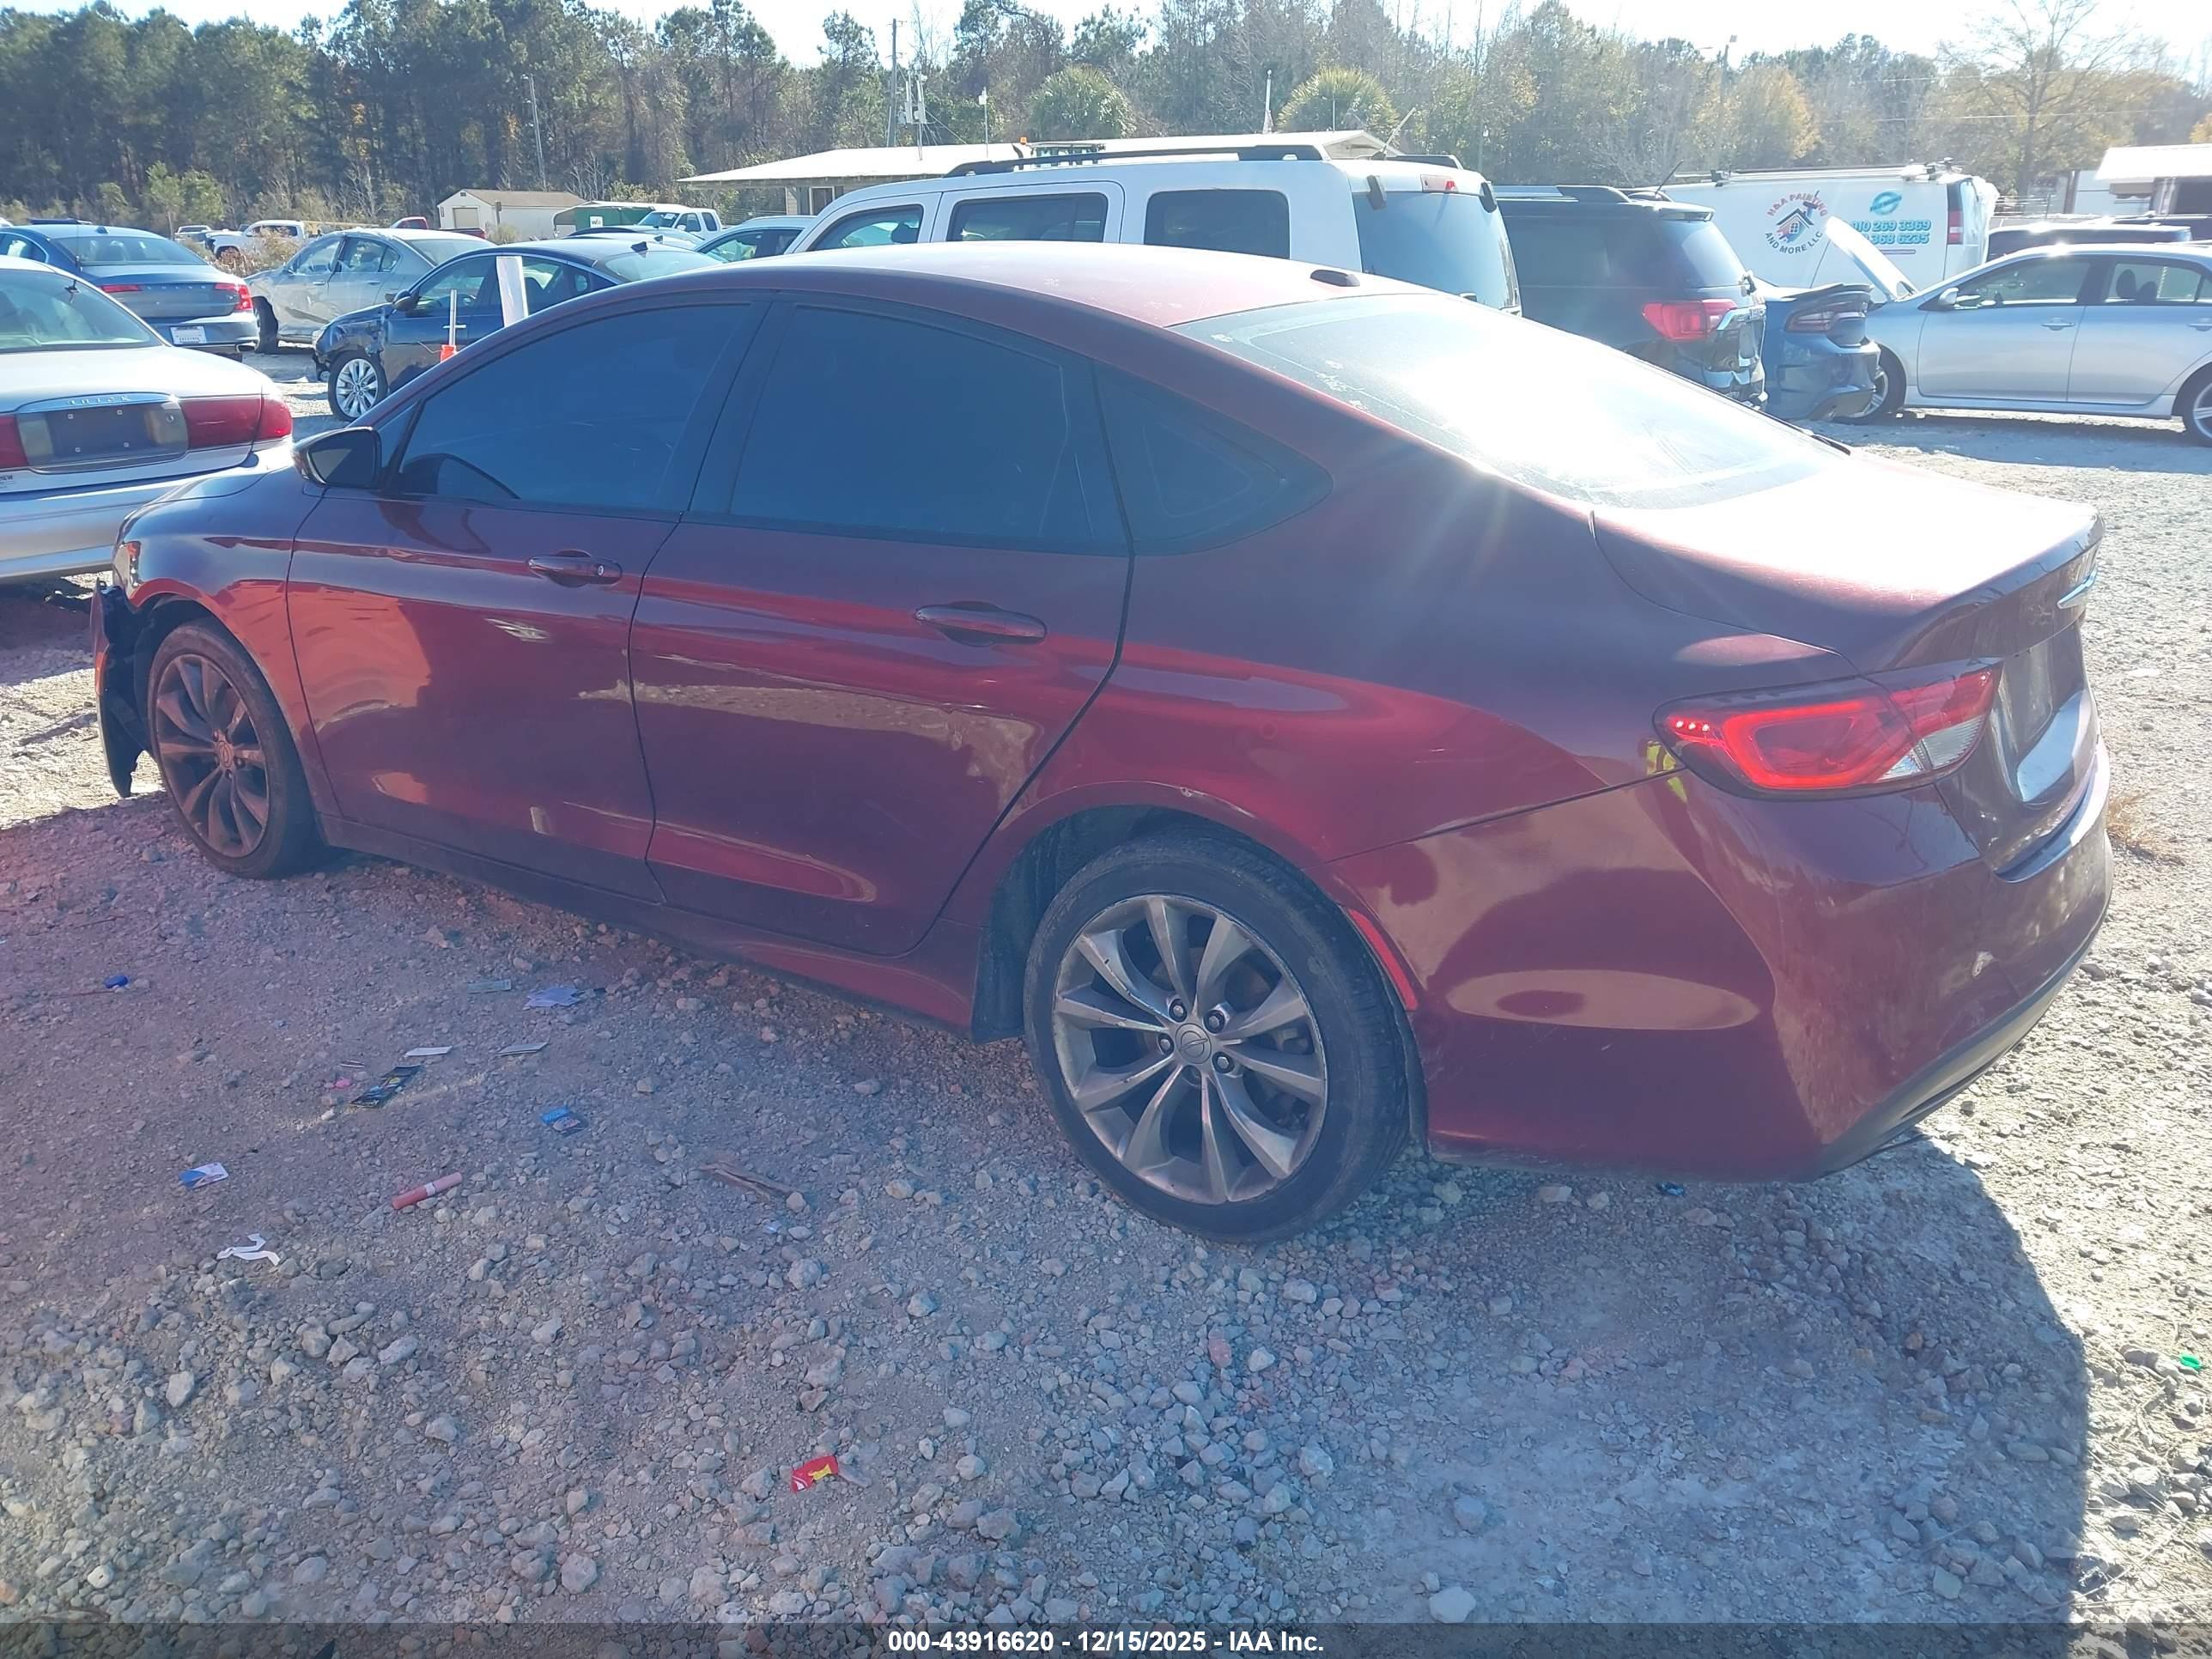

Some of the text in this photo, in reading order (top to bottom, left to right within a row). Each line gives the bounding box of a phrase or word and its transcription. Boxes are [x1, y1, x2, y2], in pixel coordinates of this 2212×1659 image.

[1872, 221, 1897, 232] 269
[1899, 220, 1931, 231] 3369
[1765, 231, 1823, 254] AND MORE LLC
